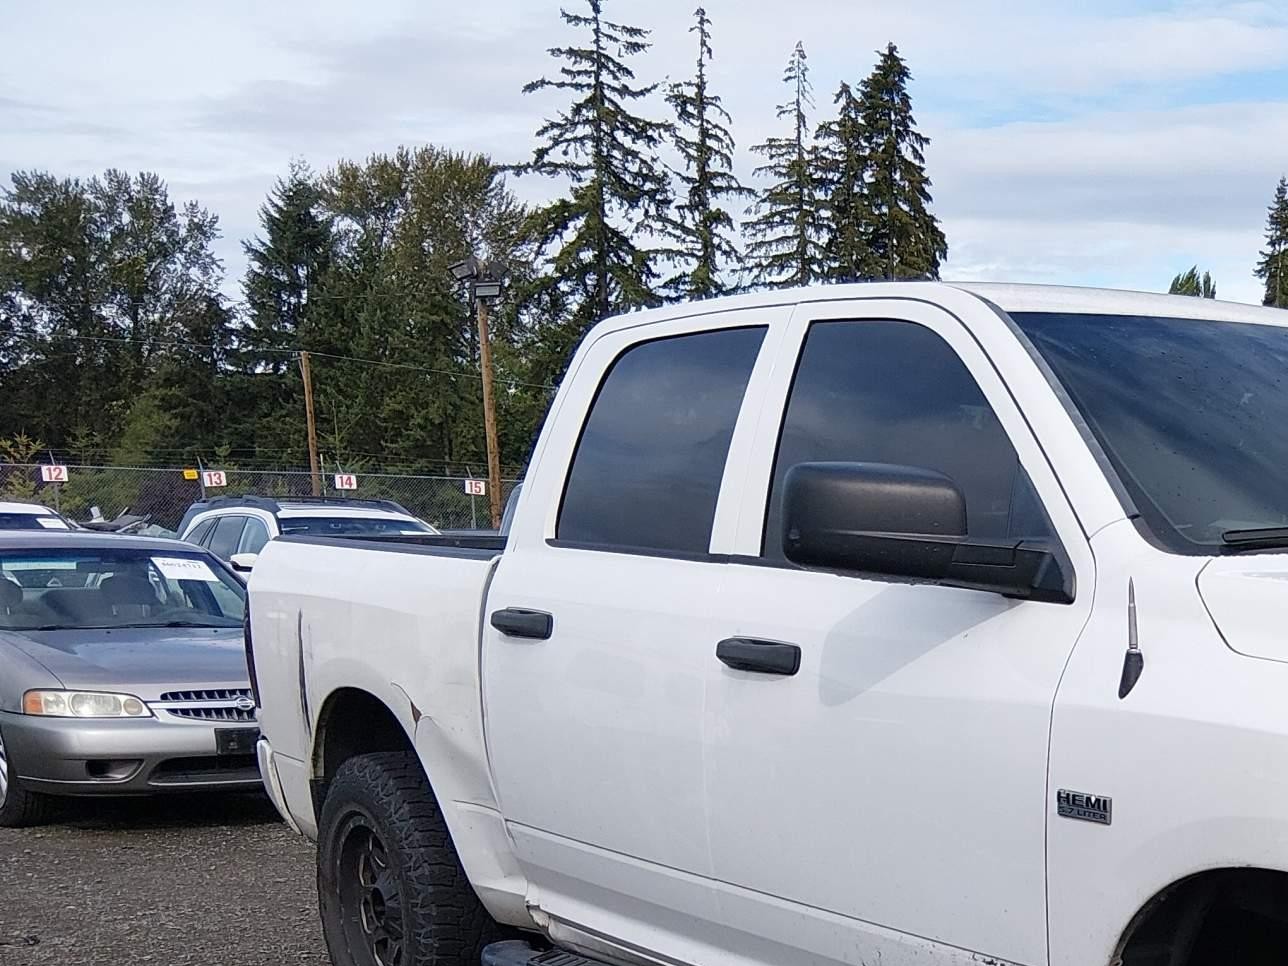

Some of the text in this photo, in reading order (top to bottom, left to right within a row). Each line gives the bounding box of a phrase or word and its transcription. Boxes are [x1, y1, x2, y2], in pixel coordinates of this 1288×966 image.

[46, 467, 64, 480] 12
[207, 472, 222, 485] 13
[339, 475, 353, 488] 14
[468, 481, 482, 494] 15
[1057, 790, 1108, 812] HEMI
[1077, 809, 1106, 820] LITER
